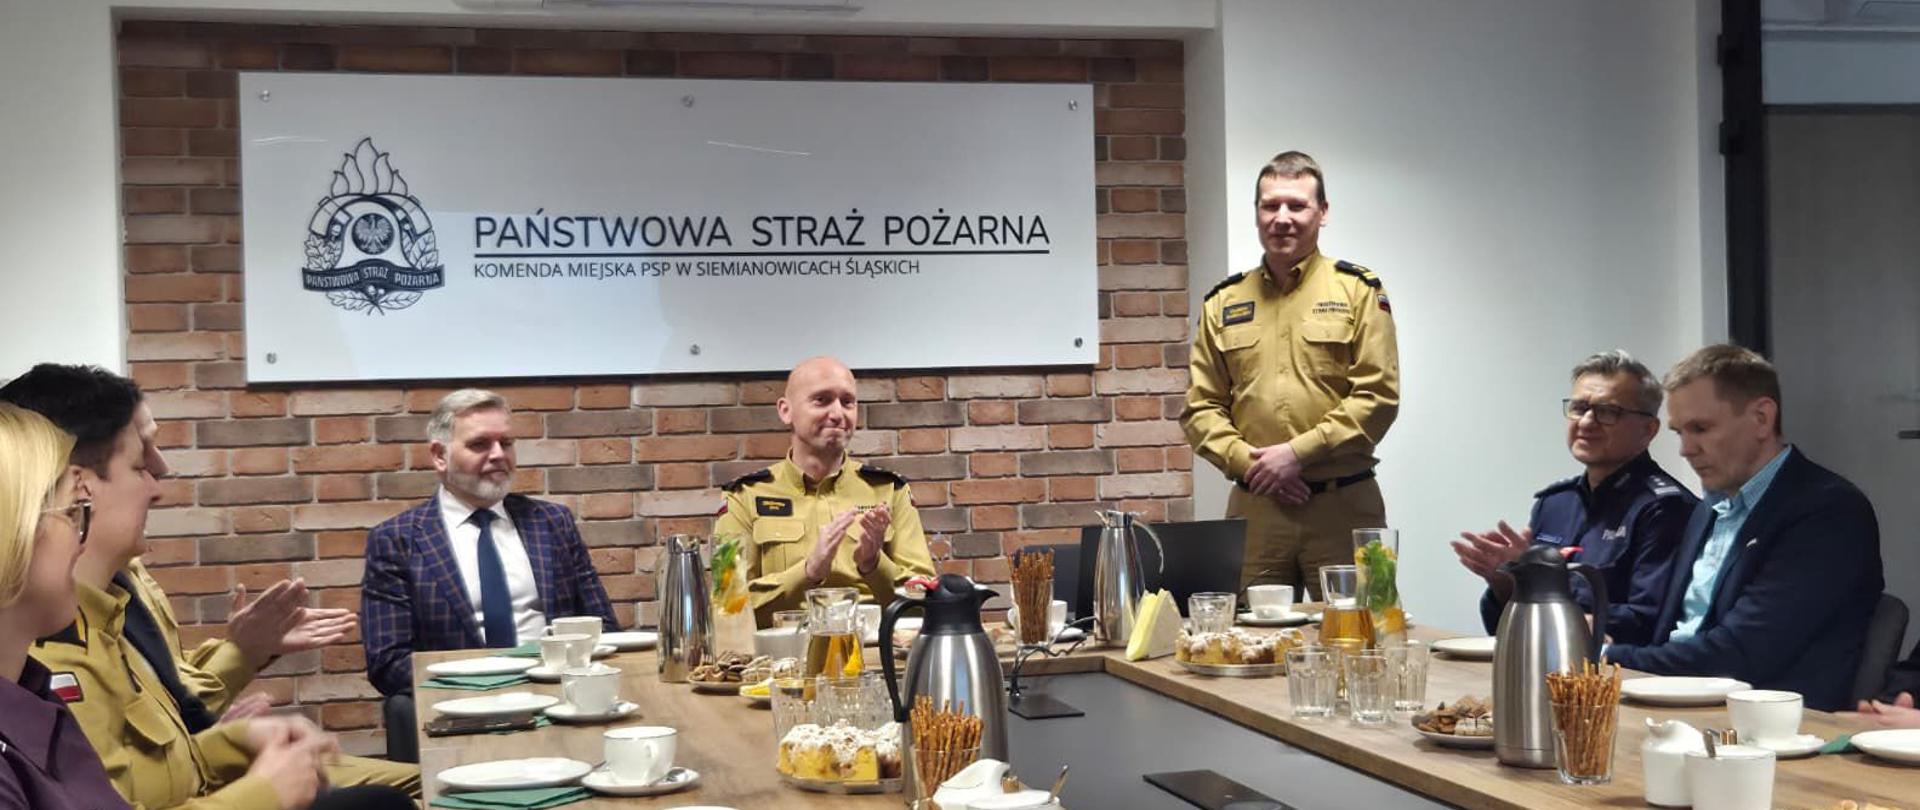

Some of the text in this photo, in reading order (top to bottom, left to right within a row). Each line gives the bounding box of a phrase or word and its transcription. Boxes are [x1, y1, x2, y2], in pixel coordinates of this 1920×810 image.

[475, 208, 1050, 248] PAŃSTWOWA STRAŻ POŻARNA
[474, 256, 920, 280] KOMENDA MIEJSKA PSP W SIEMIANOWICACH ŚLĄSKICH
